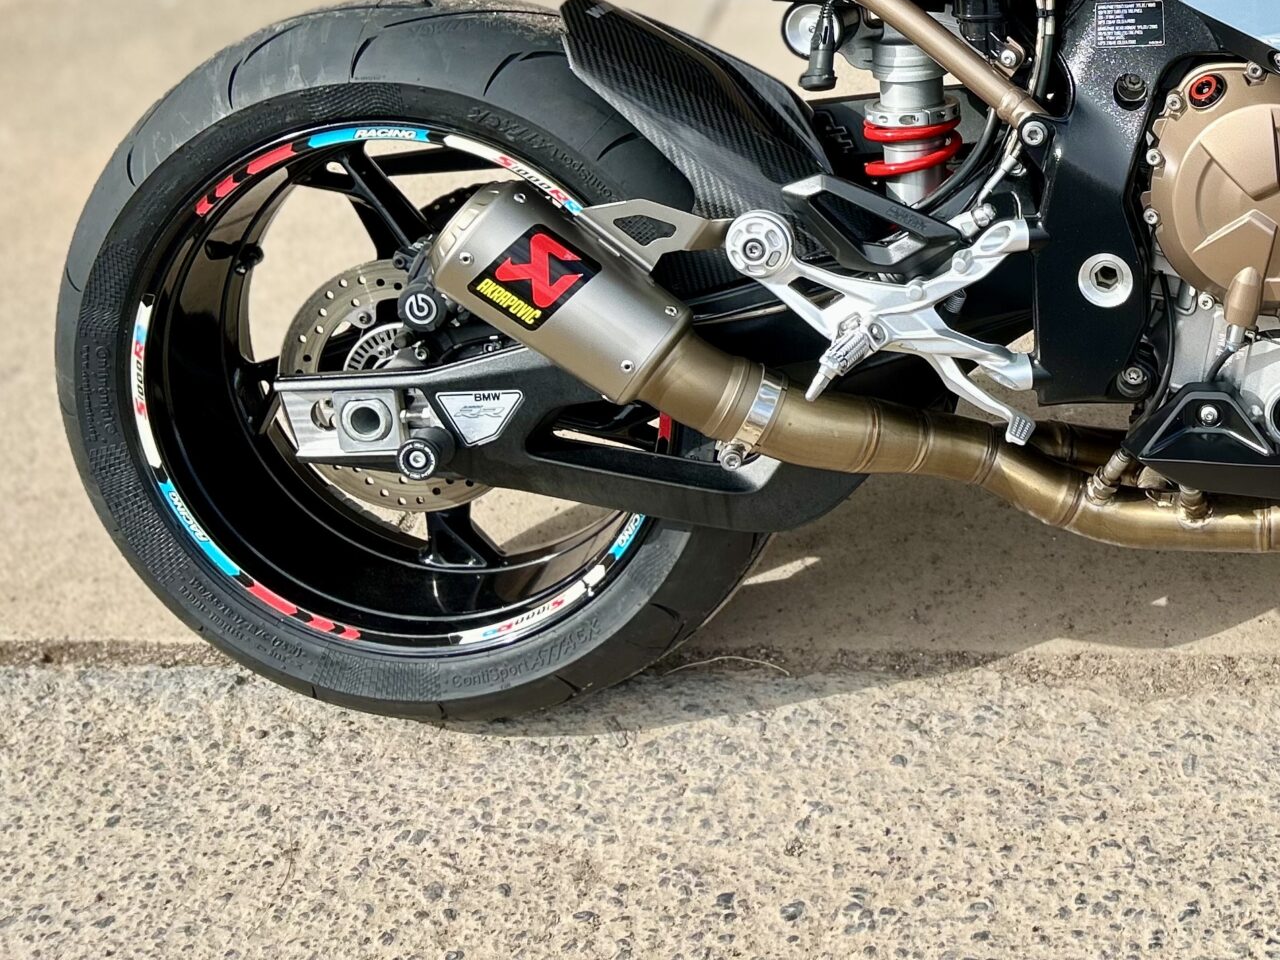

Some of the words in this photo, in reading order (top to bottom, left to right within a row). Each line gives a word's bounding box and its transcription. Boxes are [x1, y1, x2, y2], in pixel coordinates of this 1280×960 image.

[353, 128, 417, 140] RACING
[474, 393, 501, 401] BMW
[169, 491, 209, 542] RACING
[617, 513, 641, 547] CING
